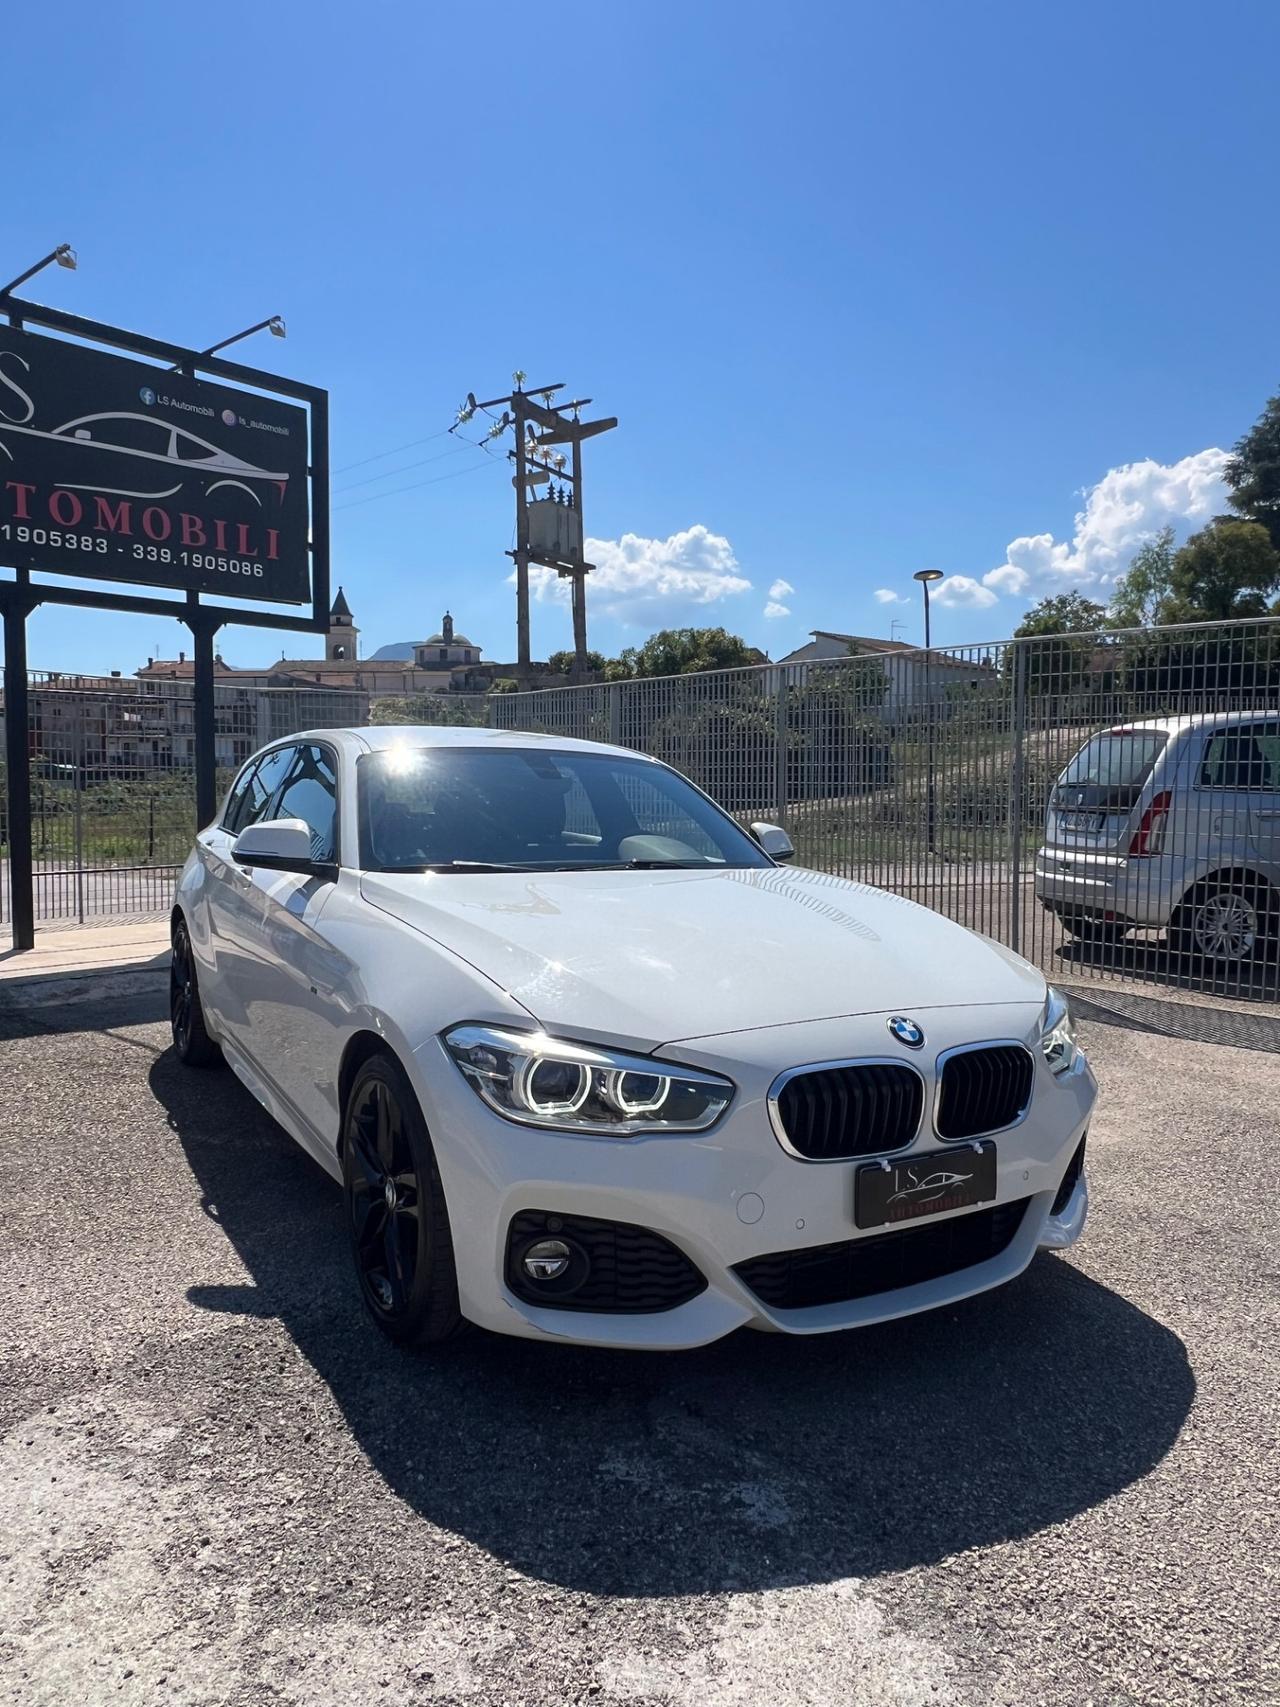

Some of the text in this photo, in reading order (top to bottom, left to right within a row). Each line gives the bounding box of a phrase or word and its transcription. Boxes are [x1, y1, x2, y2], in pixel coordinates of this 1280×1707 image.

[157, 395, 215, 417] LS Automobili
[239, 417, 290, 436] ls_automobili
[0, 524, 108, 553] 1905383
[132, 544, 264, 577] 339.1905086
